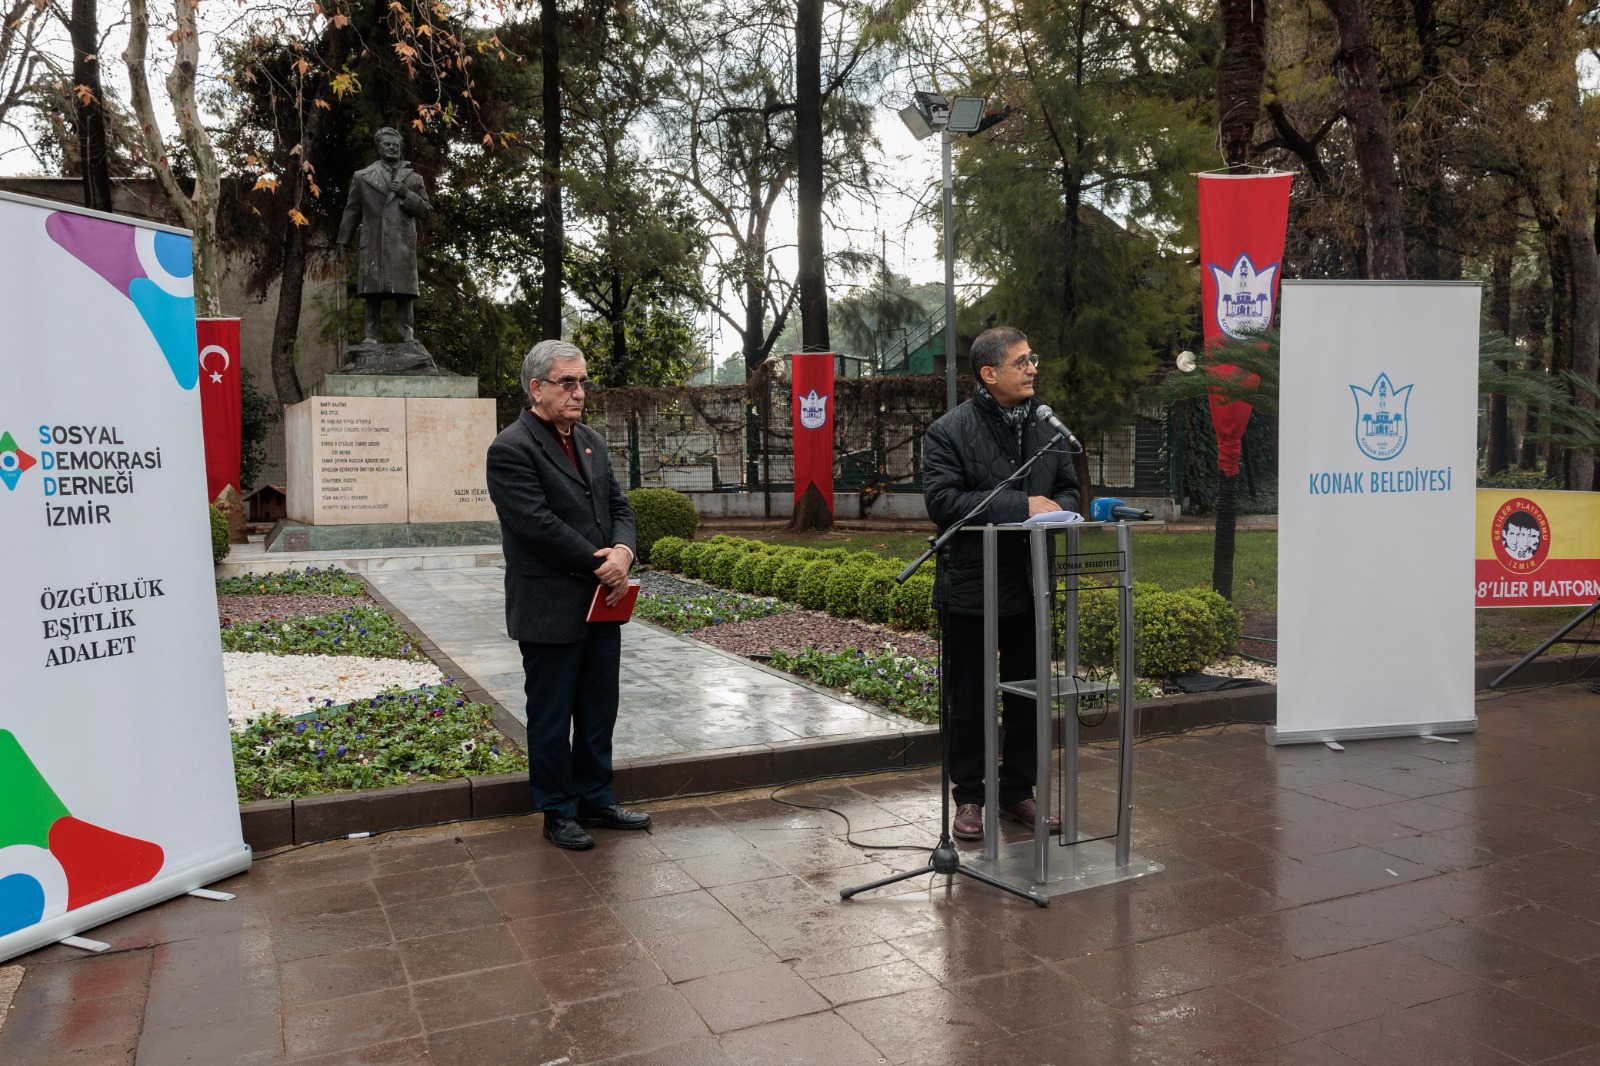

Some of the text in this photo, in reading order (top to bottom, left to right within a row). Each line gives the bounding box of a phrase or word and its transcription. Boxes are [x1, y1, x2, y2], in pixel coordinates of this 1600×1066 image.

[39, 425, 124, 444] SOSYAL
[42, 447, 162, 470] DEMOKRASİ
[44, 471, 134, 496] DERNEĞİ
[1310, 466, 1451, 494] KONAK BELEDİYESİ
[46, 500, 111, 527] İZMİR
[1516, 502, 1548, 540] PLATFORMU
[1085, 558, 1119, 568] BELEDİYESİ
[1509, 560, 1536, 570] İZMİR
[40, 577, 165, 610] ÖZGÜRLÜK
[1475, 576, 1528, 598] 8'LİLER
[42, 607, 136, 640] EŞİTLİK
[45, 636, 136, 668] ADALET
